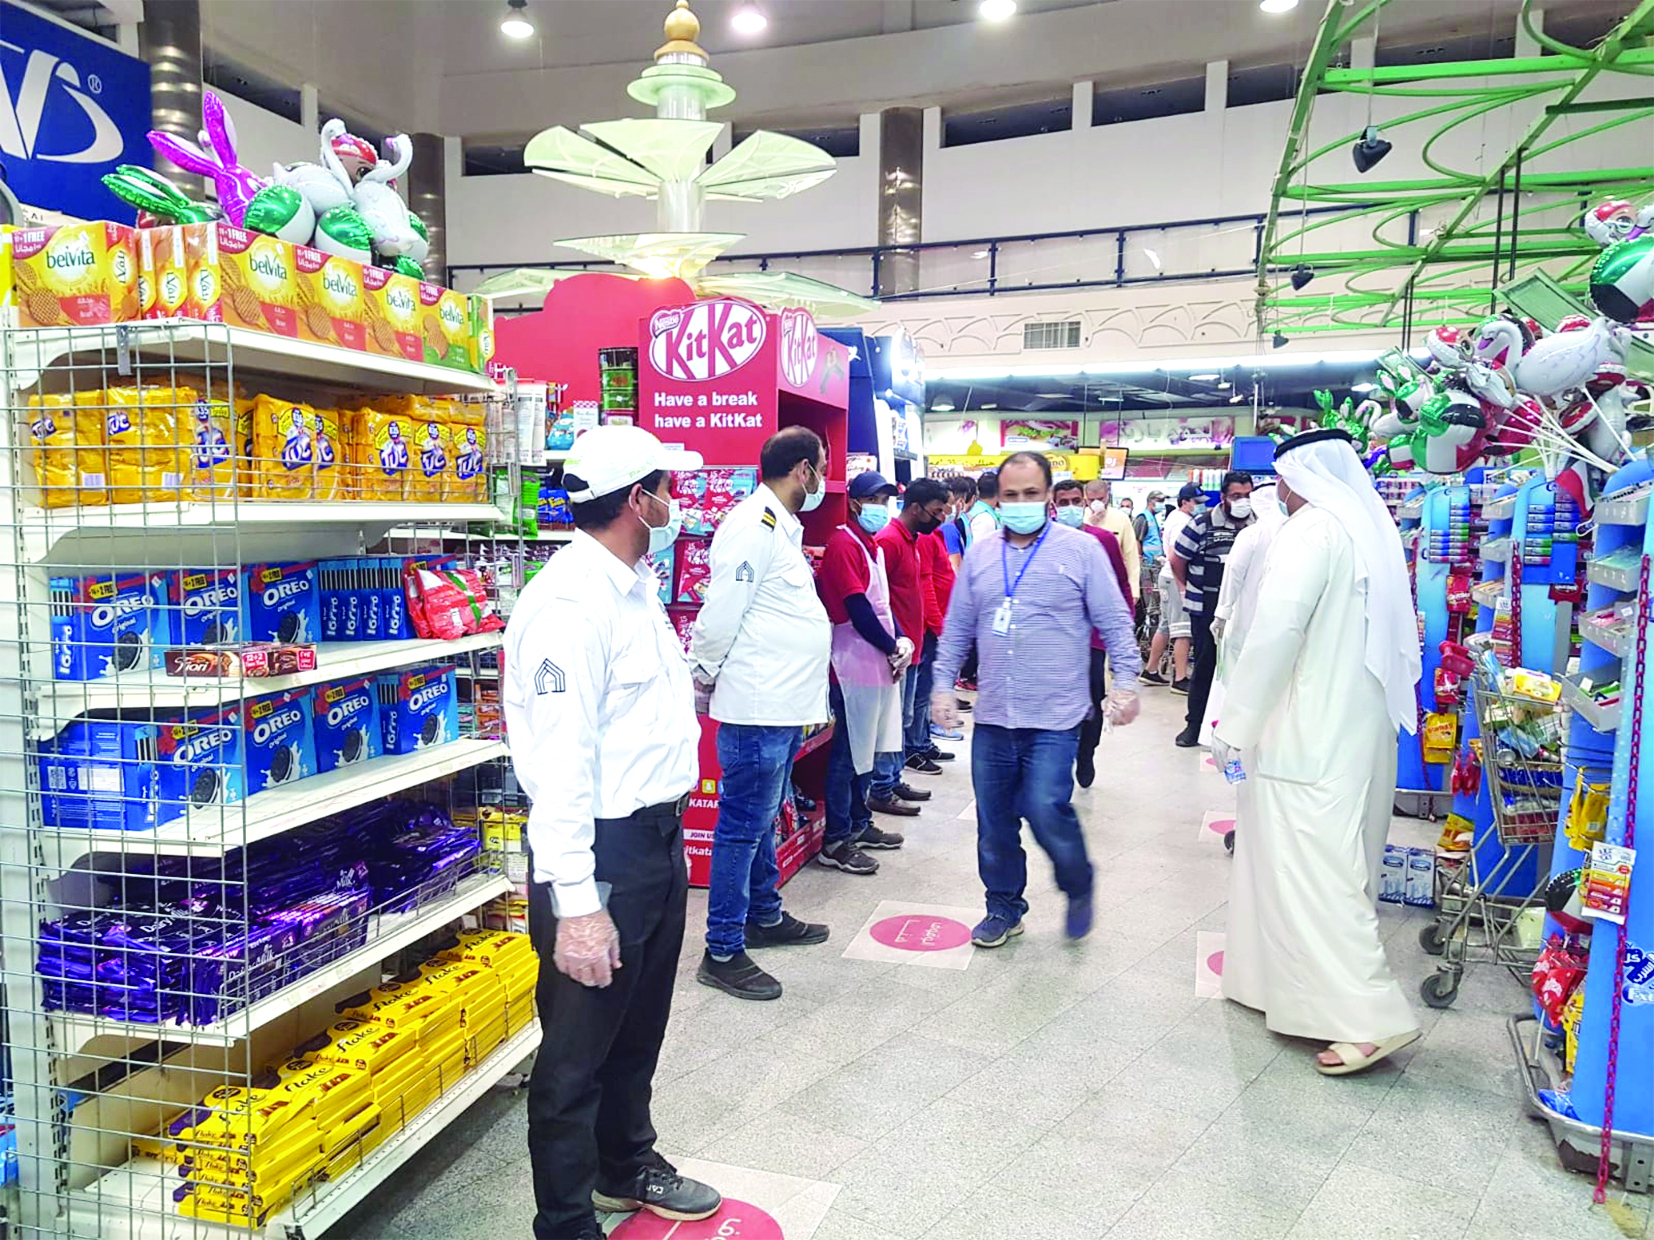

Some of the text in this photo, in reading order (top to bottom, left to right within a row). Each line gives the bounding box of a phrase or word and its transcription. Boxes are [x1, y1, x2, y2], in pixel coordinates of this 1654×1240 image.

[46, 246, 95, 268] belVita
[249, 252, 287, 280] belVita
[322, 272, 358, 297] belVita
[386, 288, 416, 311] belVita
[665, 303, 757, 380] KitKat
[787, 313, 815, 385] KitKat
[654, 391, 758, 406] Have a break
[655, 413, 762, 427] have a KitKat
[283, 436, 311, 468] TUC
[381, 443, 408, 471] TUC
[422, 449, 446, 476] TUC
[458, 453, 482, 478] TUC
[184, 587, 238, 616] OREO
[263, 580, 309, 607] OREO
[92, 595, 154, 627] OREO
[174, 656, 208, 673] Fiori
[409, 683, 448, 711] OREO
[327, 696, 369, 726] OREO
[254, 710, 300, 743] OREO
[174, 730, 232, 766] OREO
[690, 829, 705, 839] JOIN
[464, 932, 495, 951] flake
[425, 964, 461, 985] flake
[373, 989, 415, 1011] flake
[336, 1027, 374, 1053] flake
[285, 1066, 327, 1092] flake
